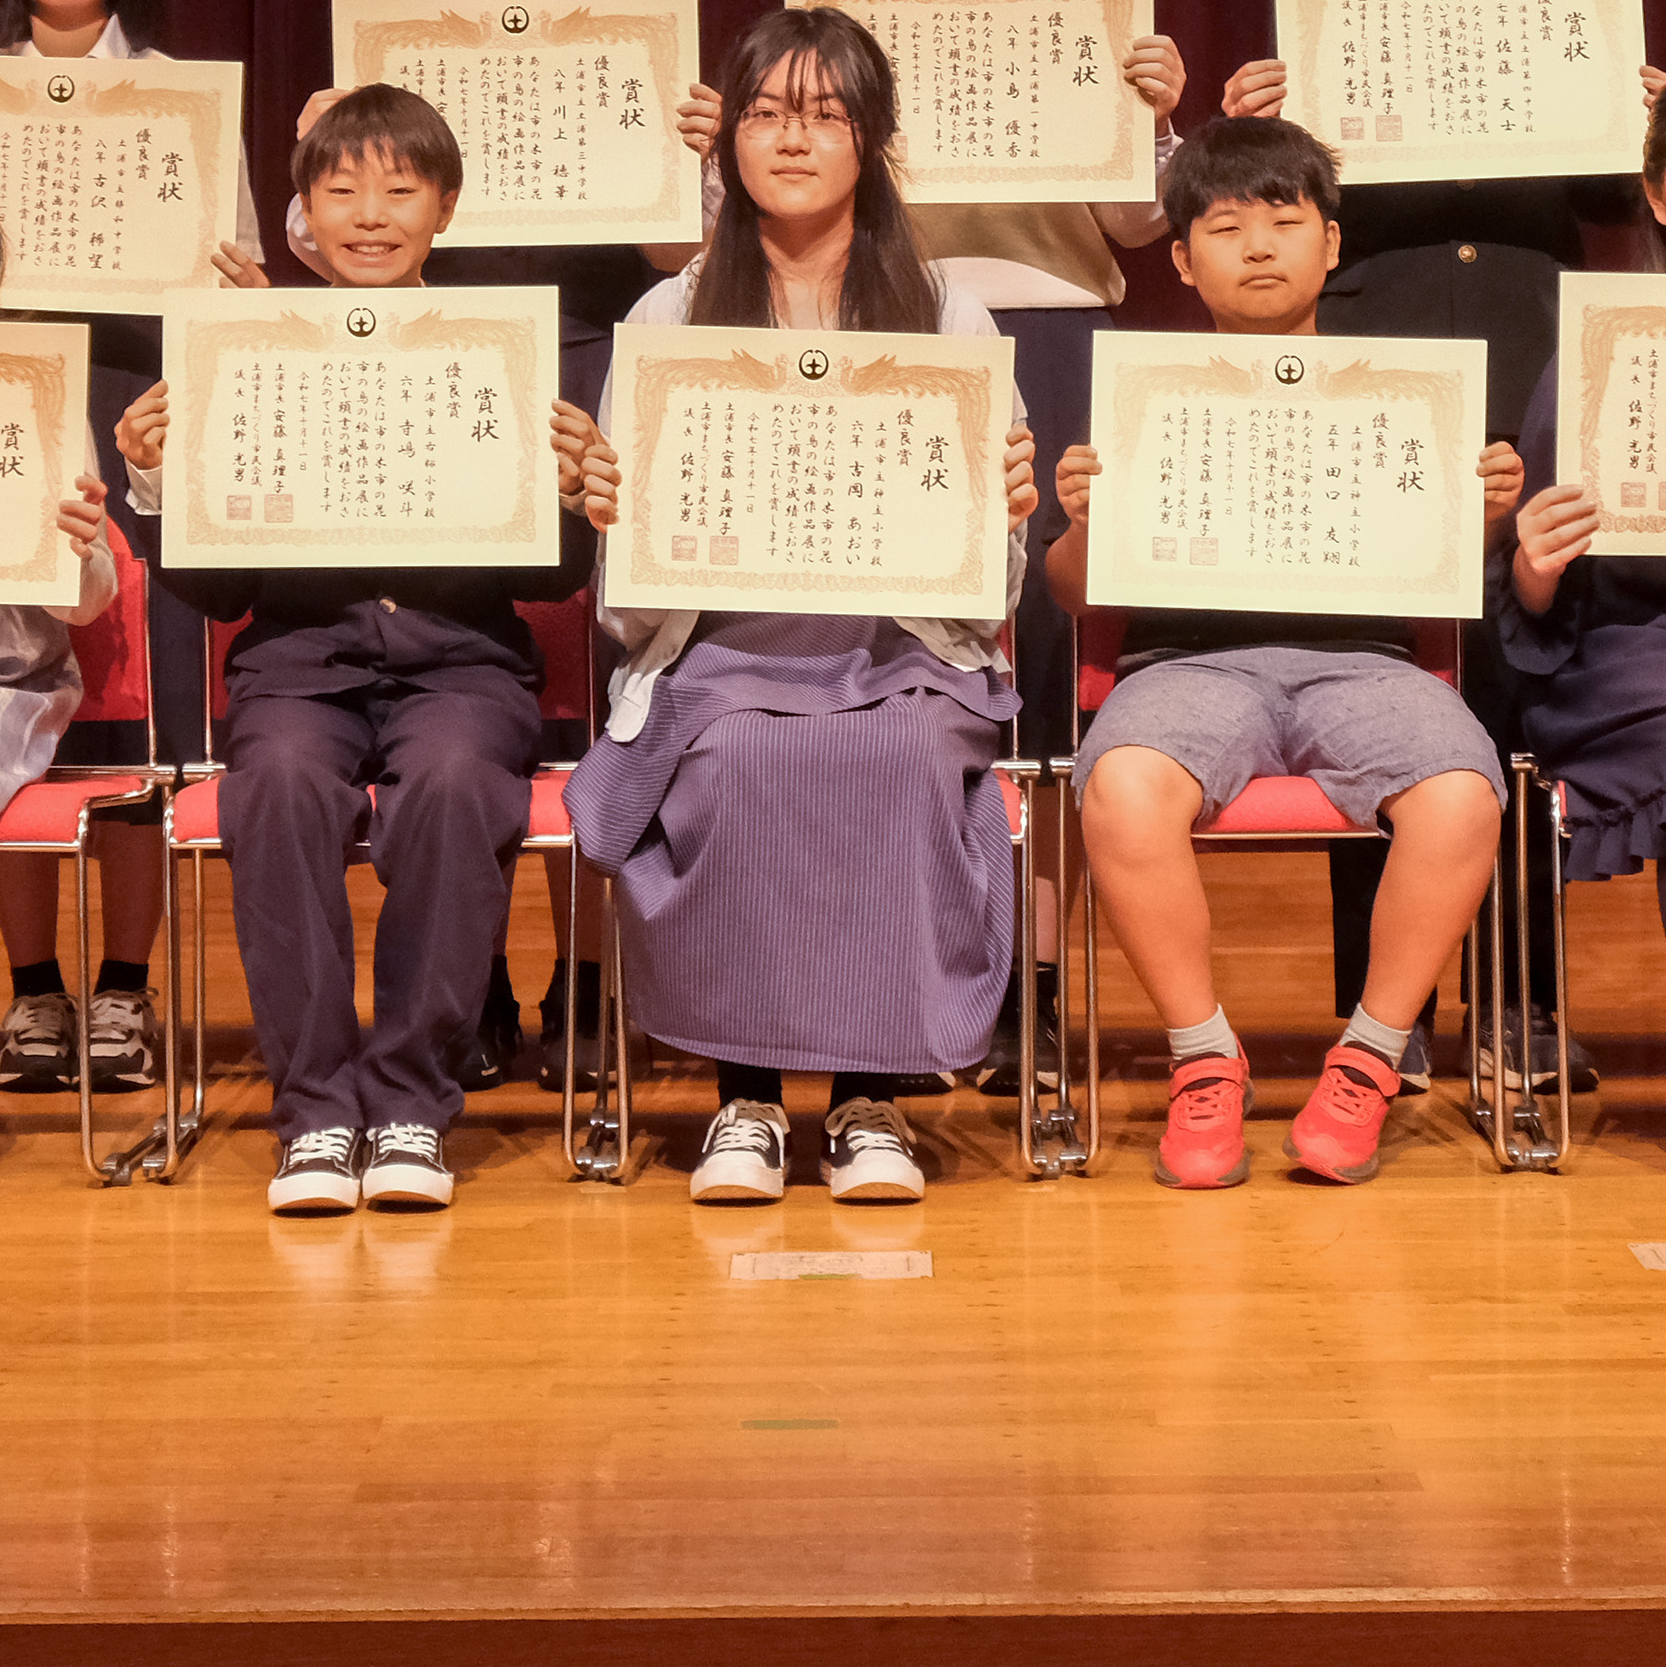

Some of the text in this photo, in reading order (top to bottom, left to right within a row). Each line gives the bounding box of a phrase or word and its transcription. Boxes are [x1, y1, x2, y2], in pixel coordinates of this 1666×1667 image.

[1047, 11, 1064, 65] 優良賞
[1496, 3, 1508, 28] 七年
[1563, 11, 1590, 62] 賞状
[553, 69, 566, 94] 八年
[594, 55, 611, 108] 優良賞
[1072, 35, 1100, 87] 賞状
[1495, 38, 1514, 75] 佐藤
[619, 78, 646, 130] 賞状
[1005, 25, 1021, 158] 八年 小島 優香
[1029, 15, 1040, 158] 土浦市立土浦第一中学校
[552, 104, 568, 140] 川上
[576, 58, 587, 200] 土浦市立土浦第三中学校
[95, 139, 107, 164] 八年
[135, 128, 152, 180] 優良賞
[157, 152, 184, 203] 賞状
[400, 375, 413, 403] 六年
[445, 362, 463, 419] 優良賞
[471, 386, 500, 443] 賞状
[232, 412, 247, 443] 佐野
[273, 408, 288, 439] 安藤
[896, 409, 915, 467] 優良賞
[1327, 424, 1339, 451] 五年
[1372, 412, 1389, 469] 優良賞
[272, 447, 286, 494] 真理子
[680, 451, 695, 483] 佐野
[720, 449, 735, 480] 安藤
[920, 435, 950, 492] 賞状
[1325, 466, 1341, 500] 田口
[1396, 438, 1425, 494] 賞状
[718, 488, 733, 536] 真理子
[846, 420, 865, 565] 六年 吉岡 あおい
[870, 421, 887, 567] 土浦市立神立小学校
[1348, 425, 1362, 567] 土浦市立神立小学校
